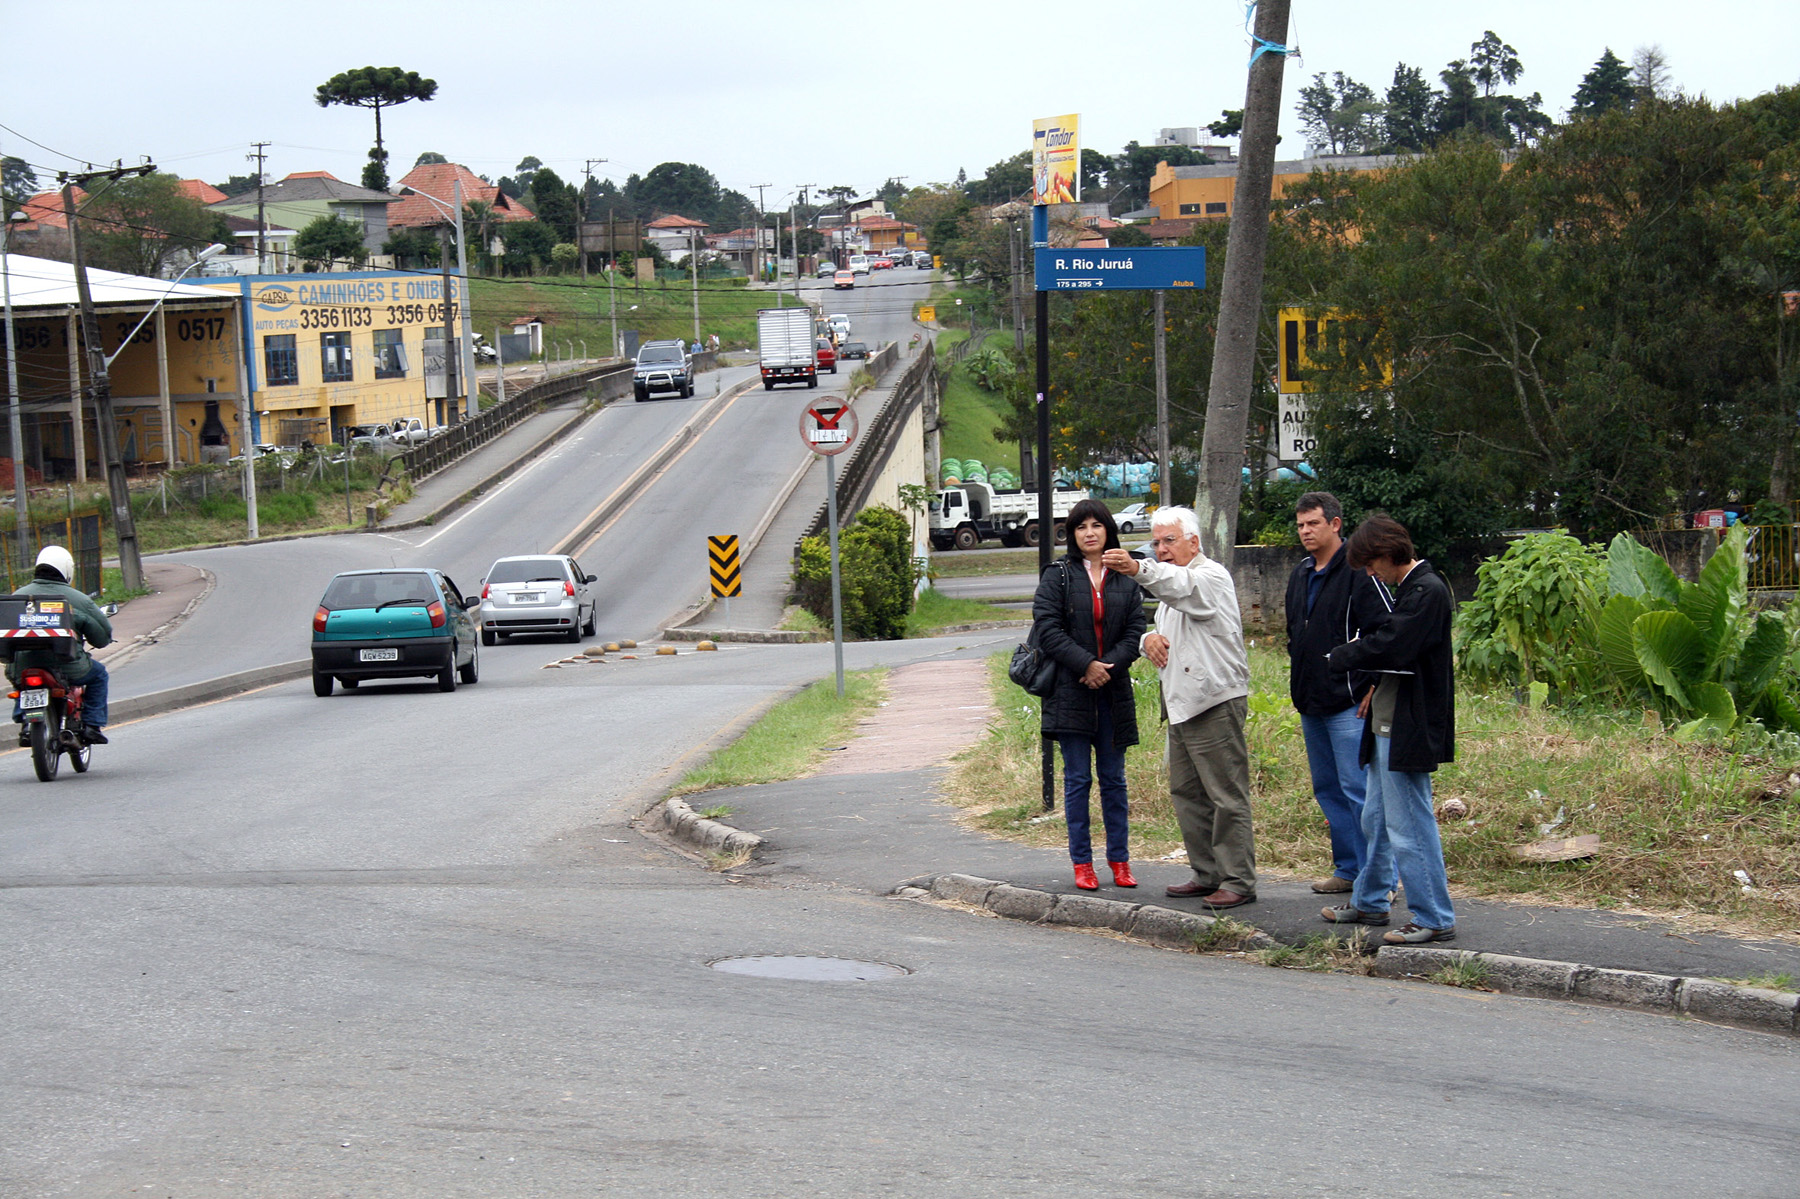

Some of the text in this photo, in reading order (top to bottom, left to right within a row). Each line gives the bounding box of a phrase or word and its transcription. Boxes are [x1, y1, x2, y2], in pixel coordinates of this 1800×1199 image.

[1046, 128, 1075, 147] Condor
[1056, 257, 1133, 270] R. Rio Juruá
[299, 280, 384, 305] CAMINHÕES
[392, 282, 400, 301] E
[387, 304, 424, 325] 3356
[178, 317, 225, 341] 0517
[256, 319, 299, 331] AUTO PEÇAS
[1282, 411, 1306, 424] AU
[1293, 439, 1316, 452] RO
